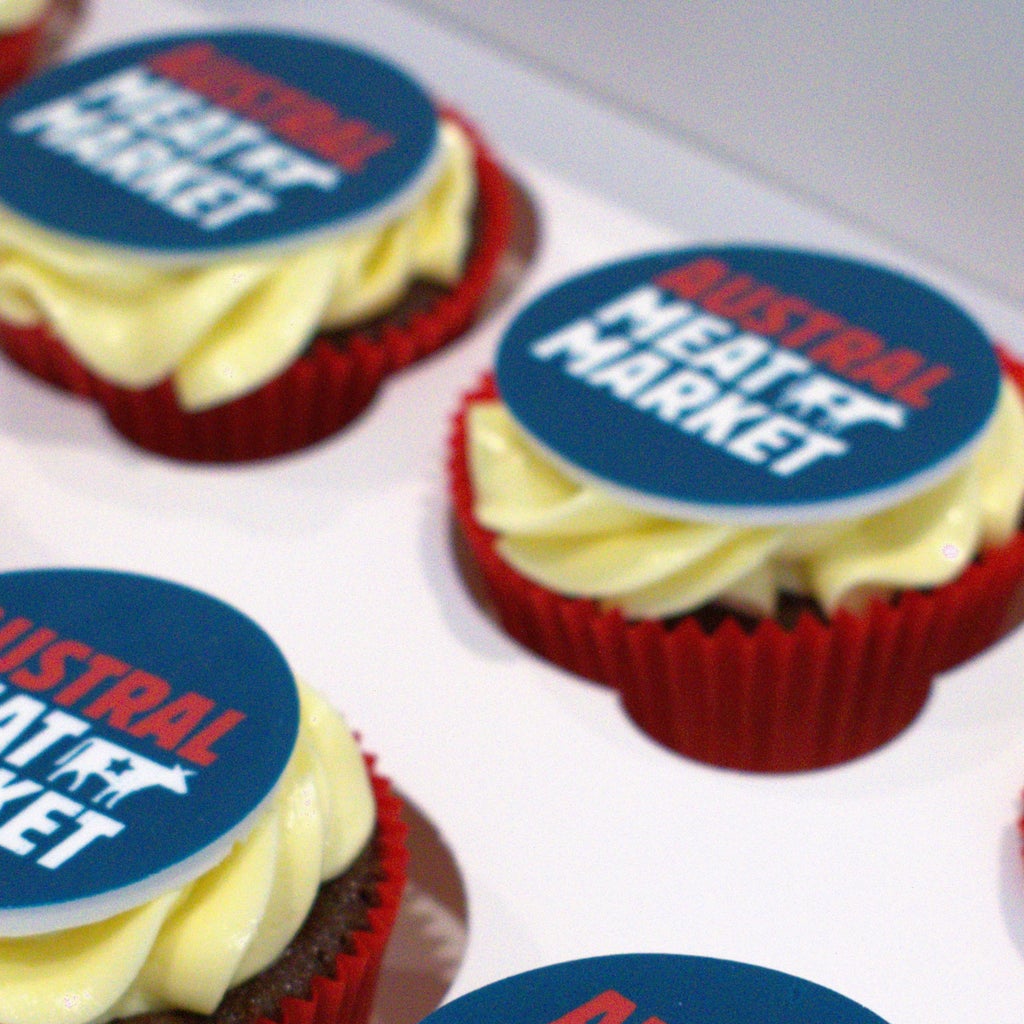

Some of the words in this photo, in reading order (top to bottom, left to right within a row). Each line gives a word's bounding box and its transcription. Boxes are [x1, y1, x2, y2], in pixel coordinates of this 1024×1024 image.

[530, 320, 850, 477] MARKET
[596, 285, 812, 394] MEAT
[652, 257, 951, 409] AUSTRAL
